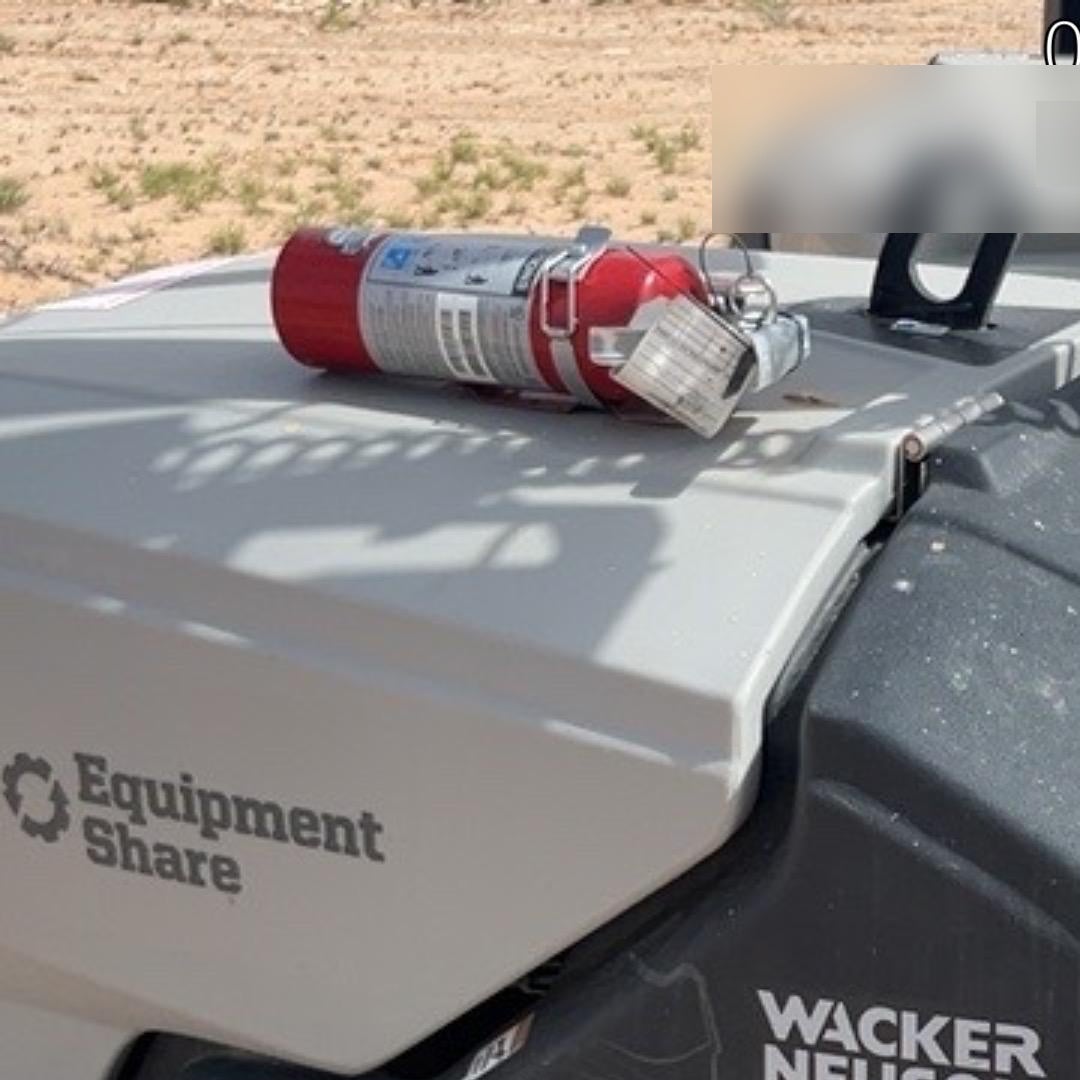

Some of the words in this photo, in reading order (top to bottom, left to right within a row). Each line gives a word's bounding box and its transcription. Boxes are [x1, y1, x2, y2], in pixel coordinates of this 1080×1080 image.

[73, 752, 385, 862] Equipment
[82, 815, 243, 894] Share
[757, 989, 1047, 1078] WACKER
